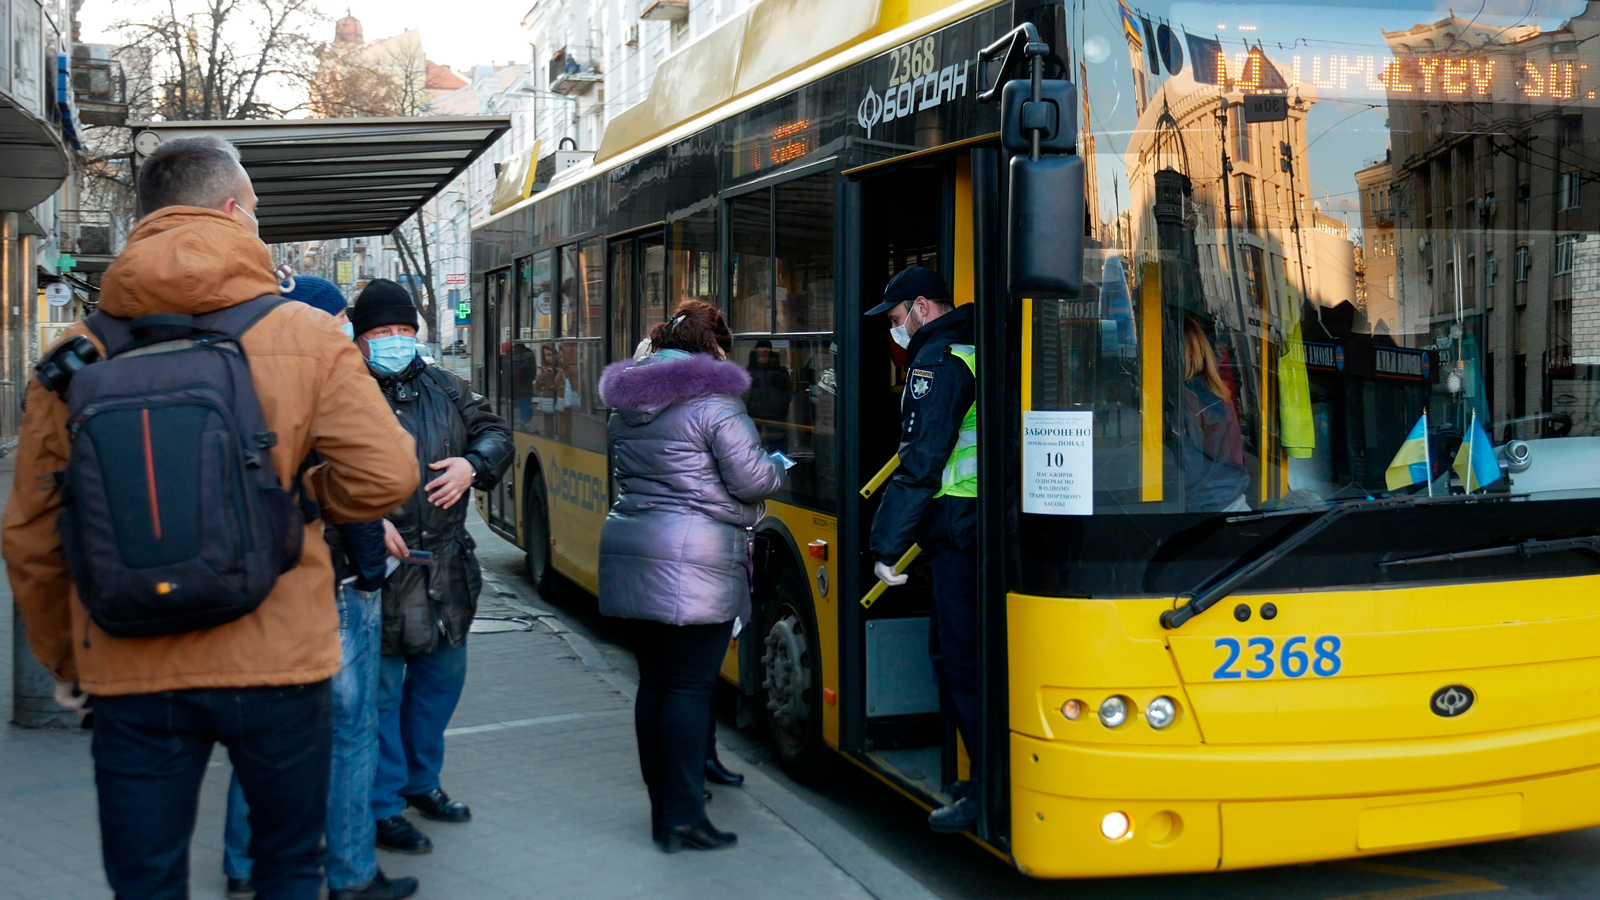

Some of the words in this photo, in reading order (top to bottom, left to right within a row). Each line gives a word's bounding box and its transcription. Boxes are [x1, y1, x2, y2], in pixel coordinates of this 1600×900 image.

[889, 36, 935, 87] 2368
[882, 59, 969, 123] БОГДАН
[1024, 427, 1091, 437] ЗАБОРОНЕНО
[1046, 452, 1064, 467] 10
[562, 467, 608, 515] БОГДАН
[1212, 636, 1342, 678] 2368
